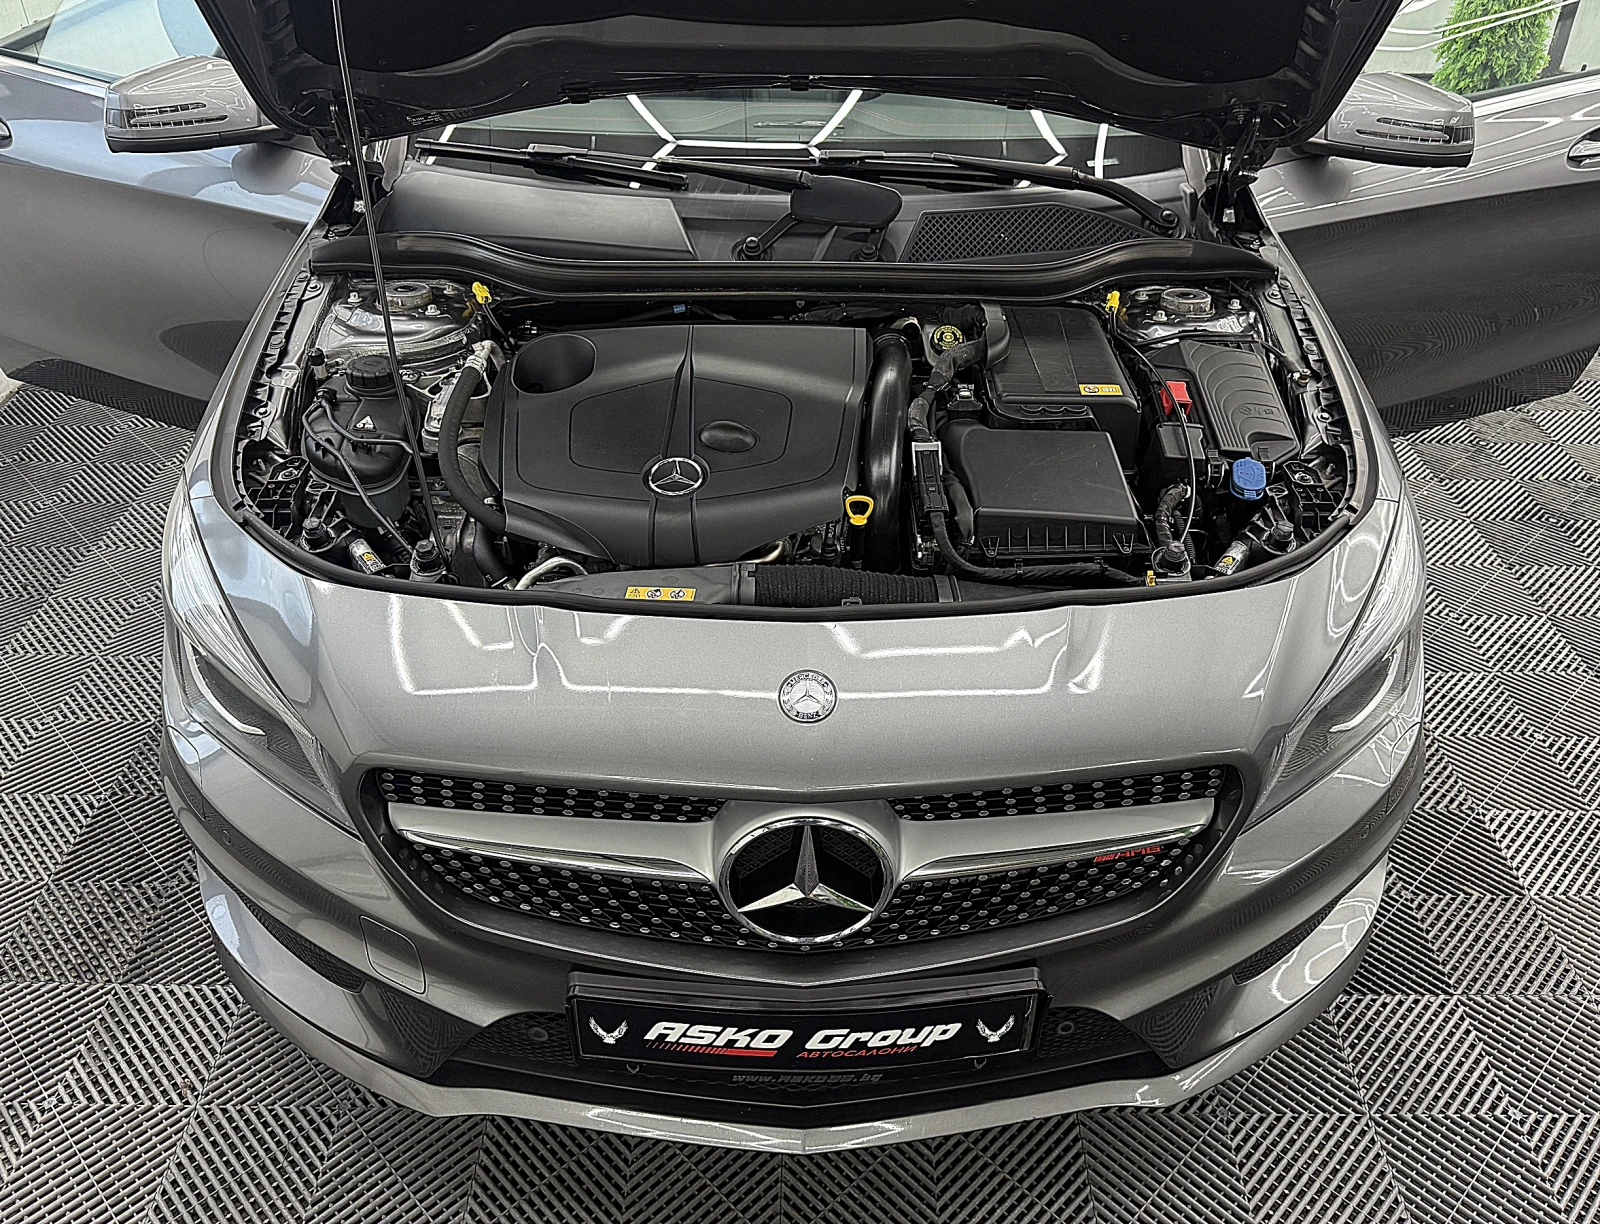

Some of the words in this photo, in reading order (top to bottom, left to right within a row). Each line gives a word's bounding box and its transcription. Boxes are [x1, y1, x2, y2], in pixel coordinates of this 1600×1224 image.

[643, 1021, 794, 1049] ASKO
[804, 1022, 963, 1050] Group
[796, 1045, 918, 1058] АВТОСАЛОНИ
